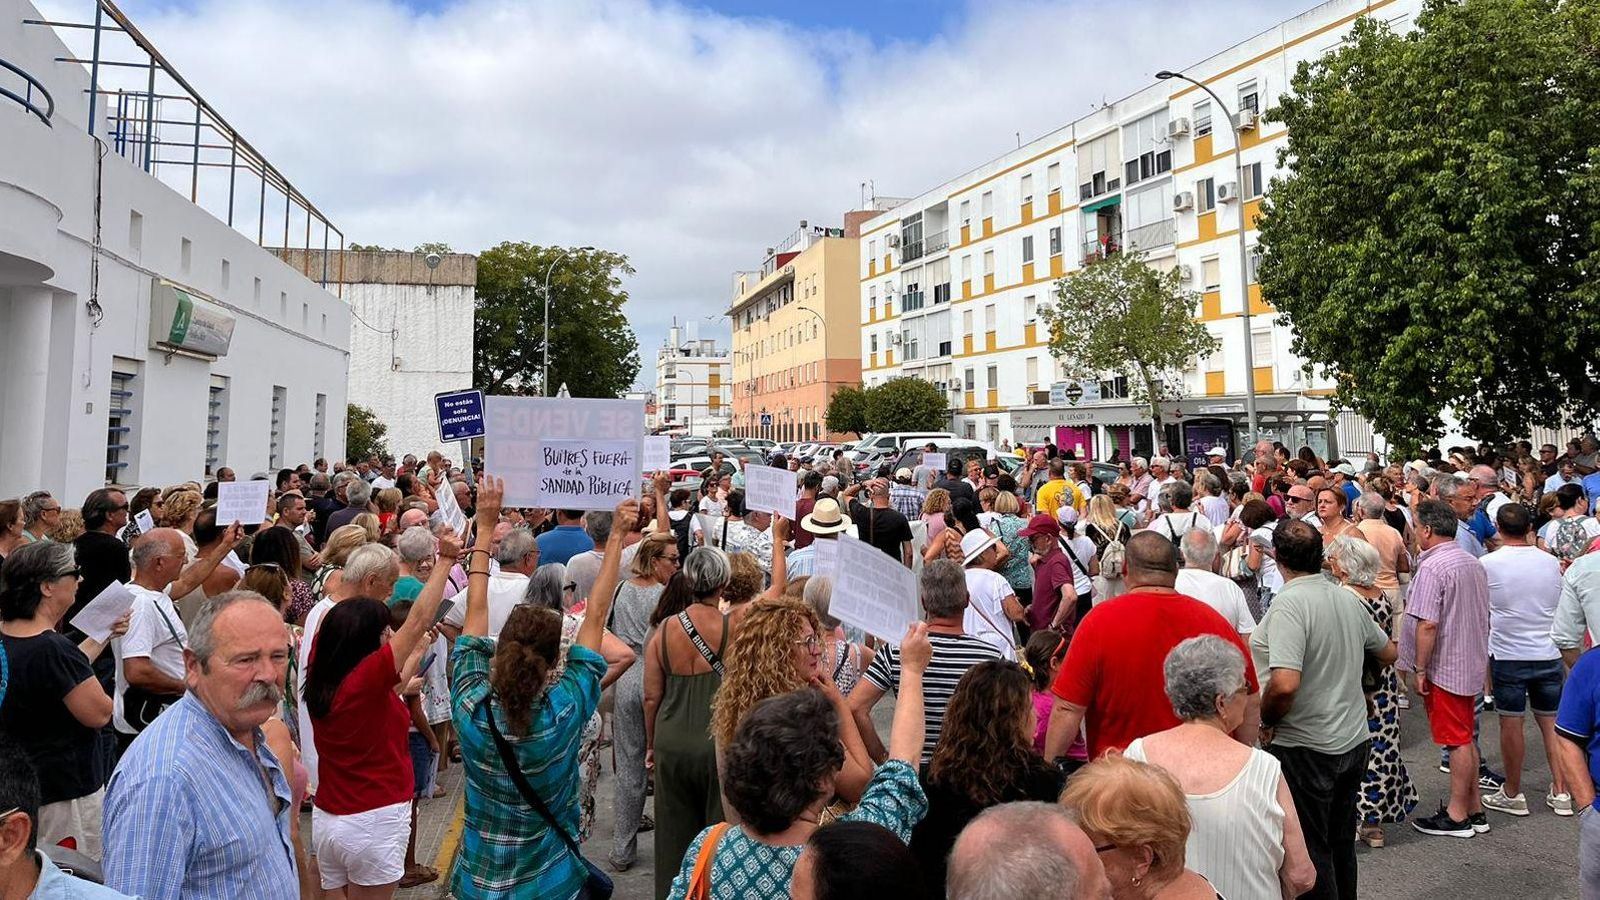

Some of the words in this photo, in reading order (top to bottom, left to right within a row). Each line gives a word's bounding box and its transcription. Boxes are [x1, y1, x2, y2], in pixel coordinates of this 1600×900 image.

[455, 399, 474, 407] estás
[441, 414, 481, 426] ¡DENUNCIA!
[543, 447, 588, 468] BUITRES
[593, 450, 632, 467] FUERA
[1193, 456, 1207, 466] 016
[562, 467, 572, 475] de
[575, 467, 582, 476] la
[540, 478, 585, 495] SANIDAD
[587, 475, 633, 496] PÚBLICA
[678, 610, 695, 636] BIMBA
[692, 634, 714, 662] BIMBA
